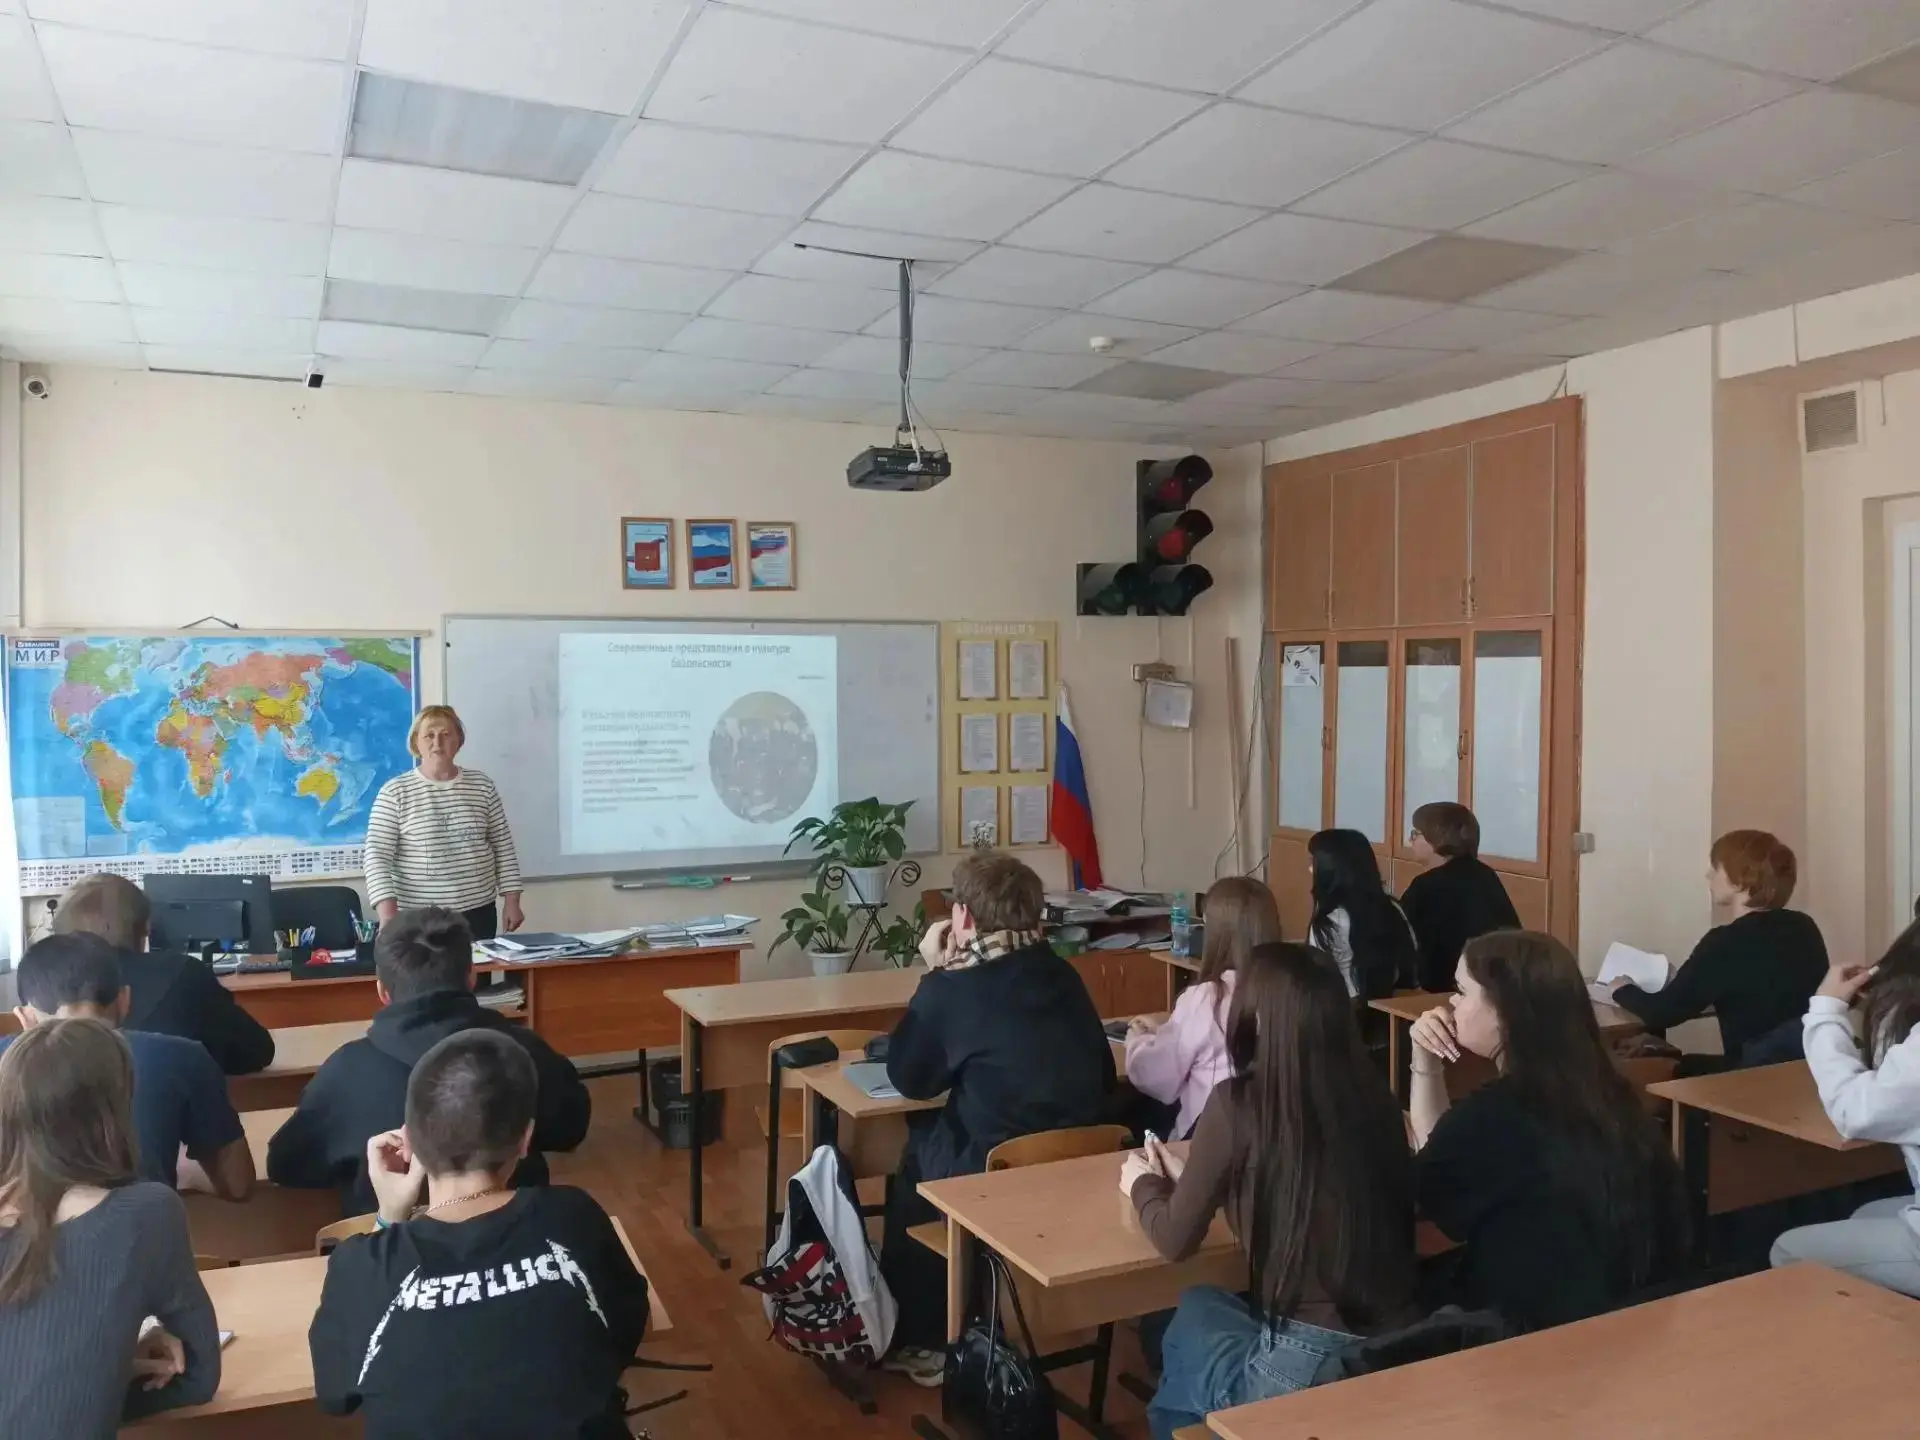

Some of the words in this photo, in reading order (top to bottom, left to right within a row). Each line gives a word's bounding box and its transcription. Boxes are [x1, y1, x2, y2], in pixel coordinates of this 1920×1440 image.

[16, 650, 60, 661] МИР
[676, 644, 742, 655] представления
[752, 645, 791, 656] культуре
[671, 657, 731, 668] безопасности
